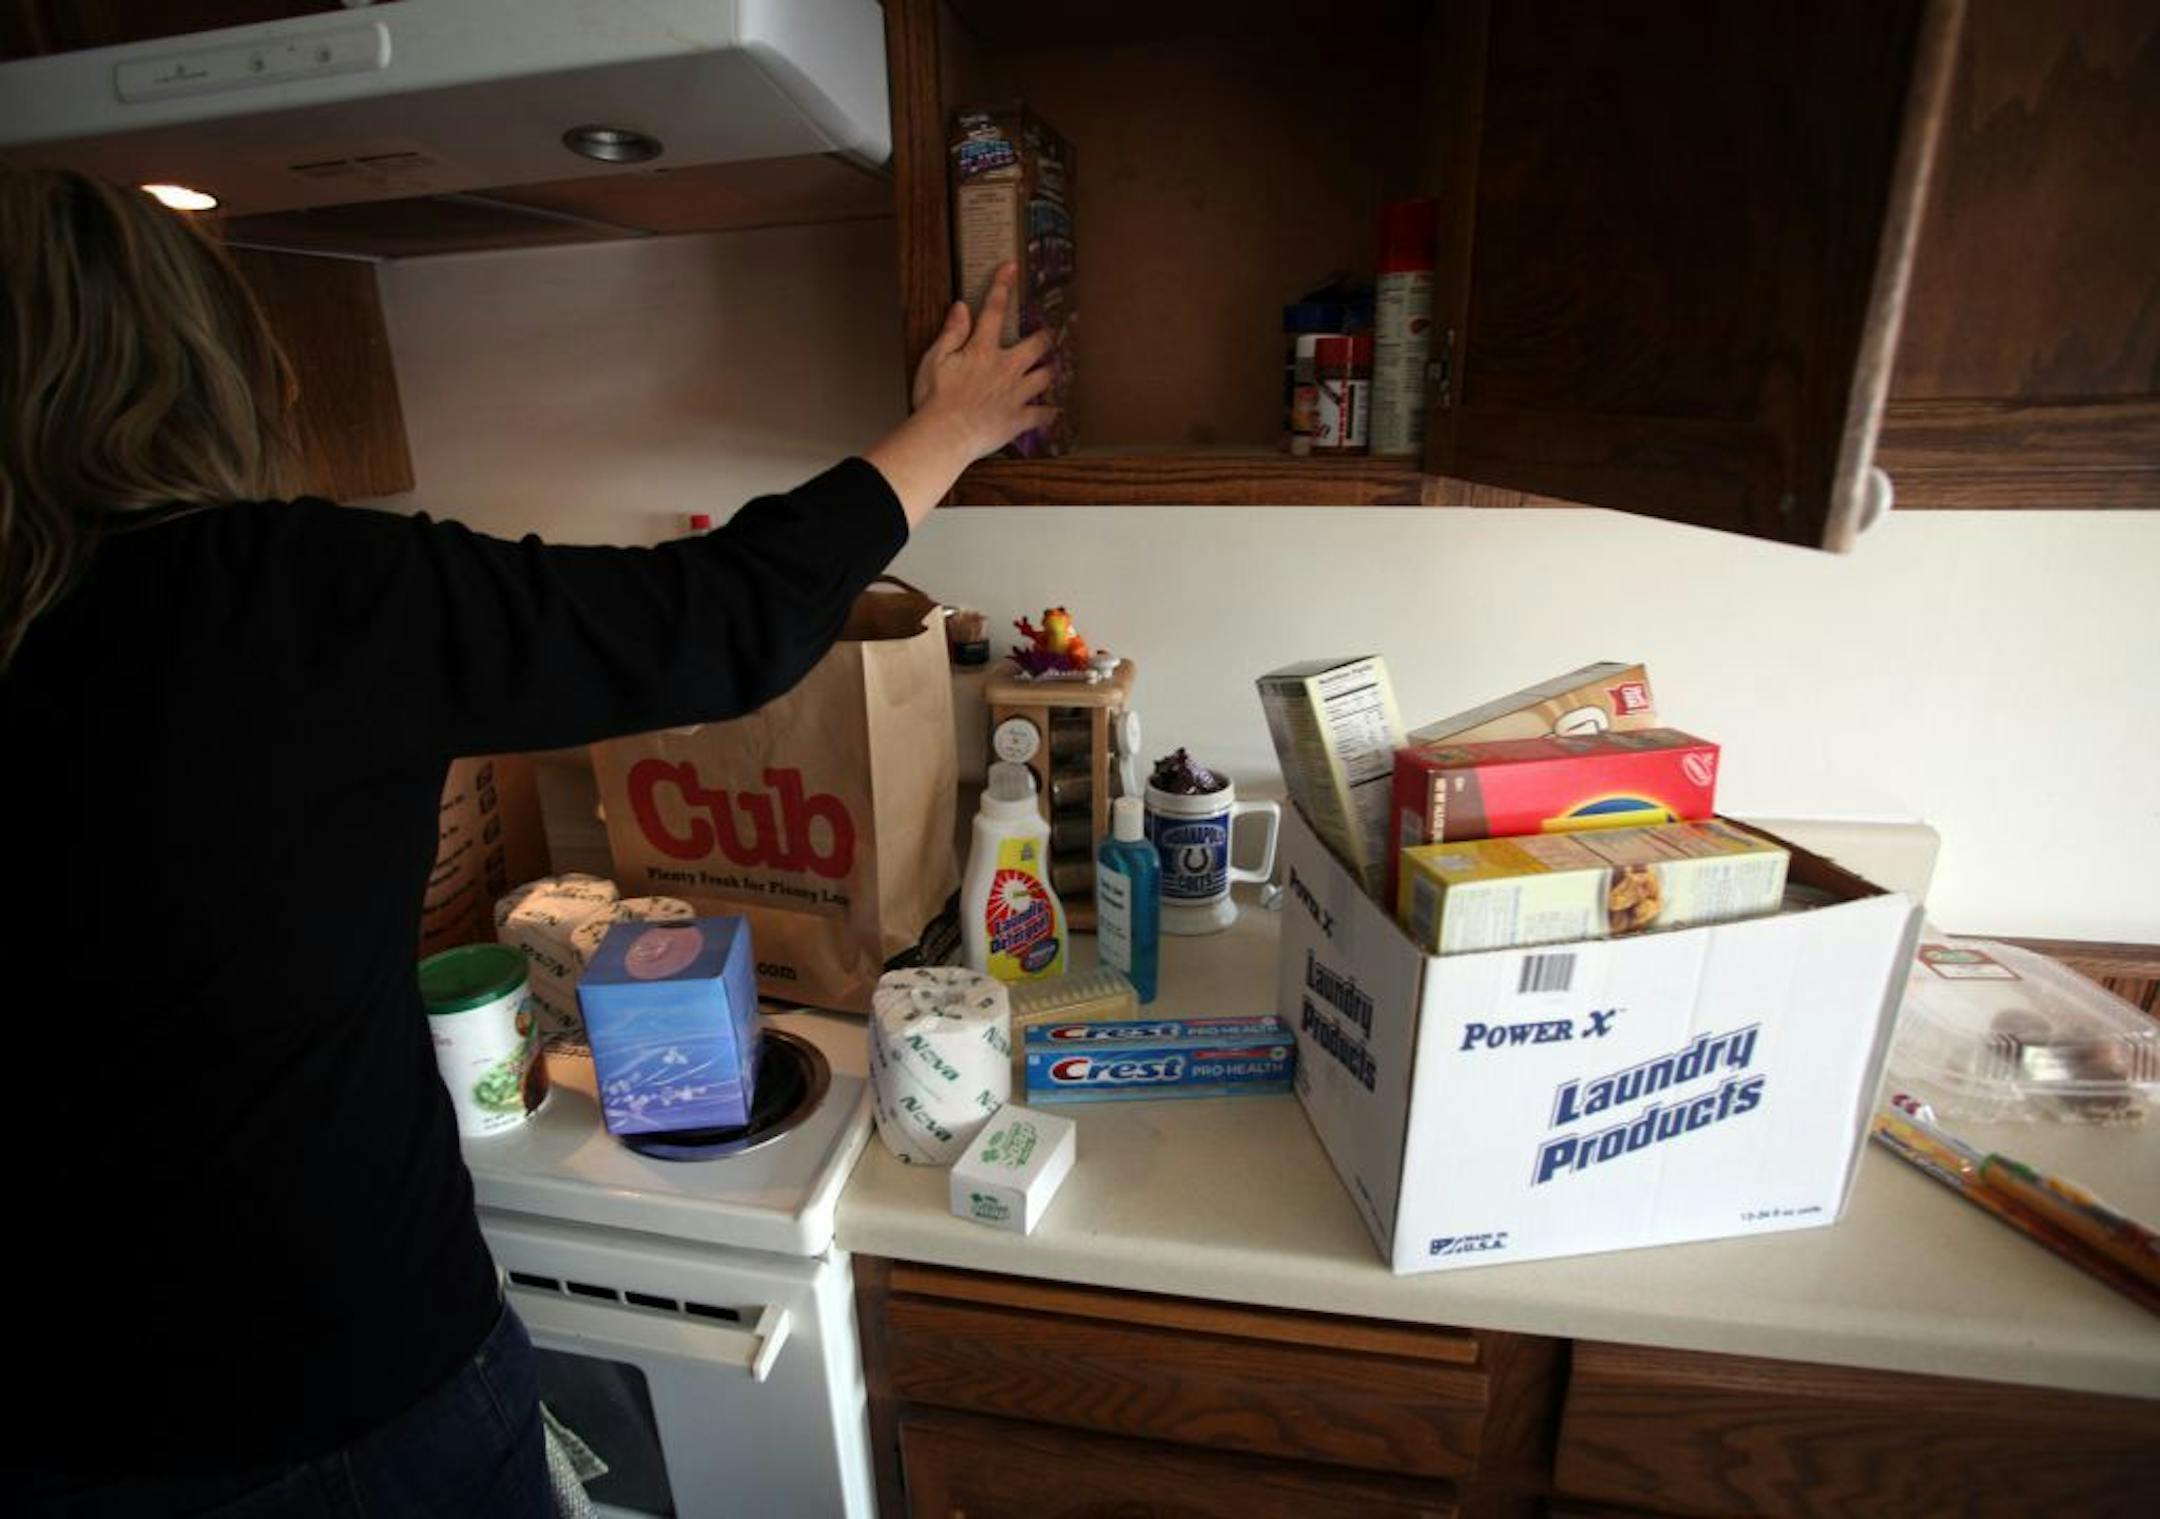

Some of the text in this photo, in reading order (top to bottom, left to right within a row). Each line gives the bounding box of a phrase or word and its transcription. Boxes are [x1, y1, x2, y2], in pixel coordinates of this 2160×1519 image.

[627, 758, 856, 880] Cub
[647, 867, 696, 886] Plenty
[699, 869, 740, 888] Fresh
[741, 876, 766, 894] for
[768, 881, 818, 903] Plenty
[1306, 948, 1376, 1042] Laundry
[1048, 1023, 1181, 1041] Crest
[1302, 993, 1378, 1093] Products
[1460, 1020, 1573, 1051] POWER
[906, 1033, 960, 1081] Nova
[1050, 1055, 1187, 1084] Crest
[1549, 1022, 1762, 1130] Laundry
[901, 1095, 953, 1142] Nova
[1531, 1073, 1767, 1187] Products
